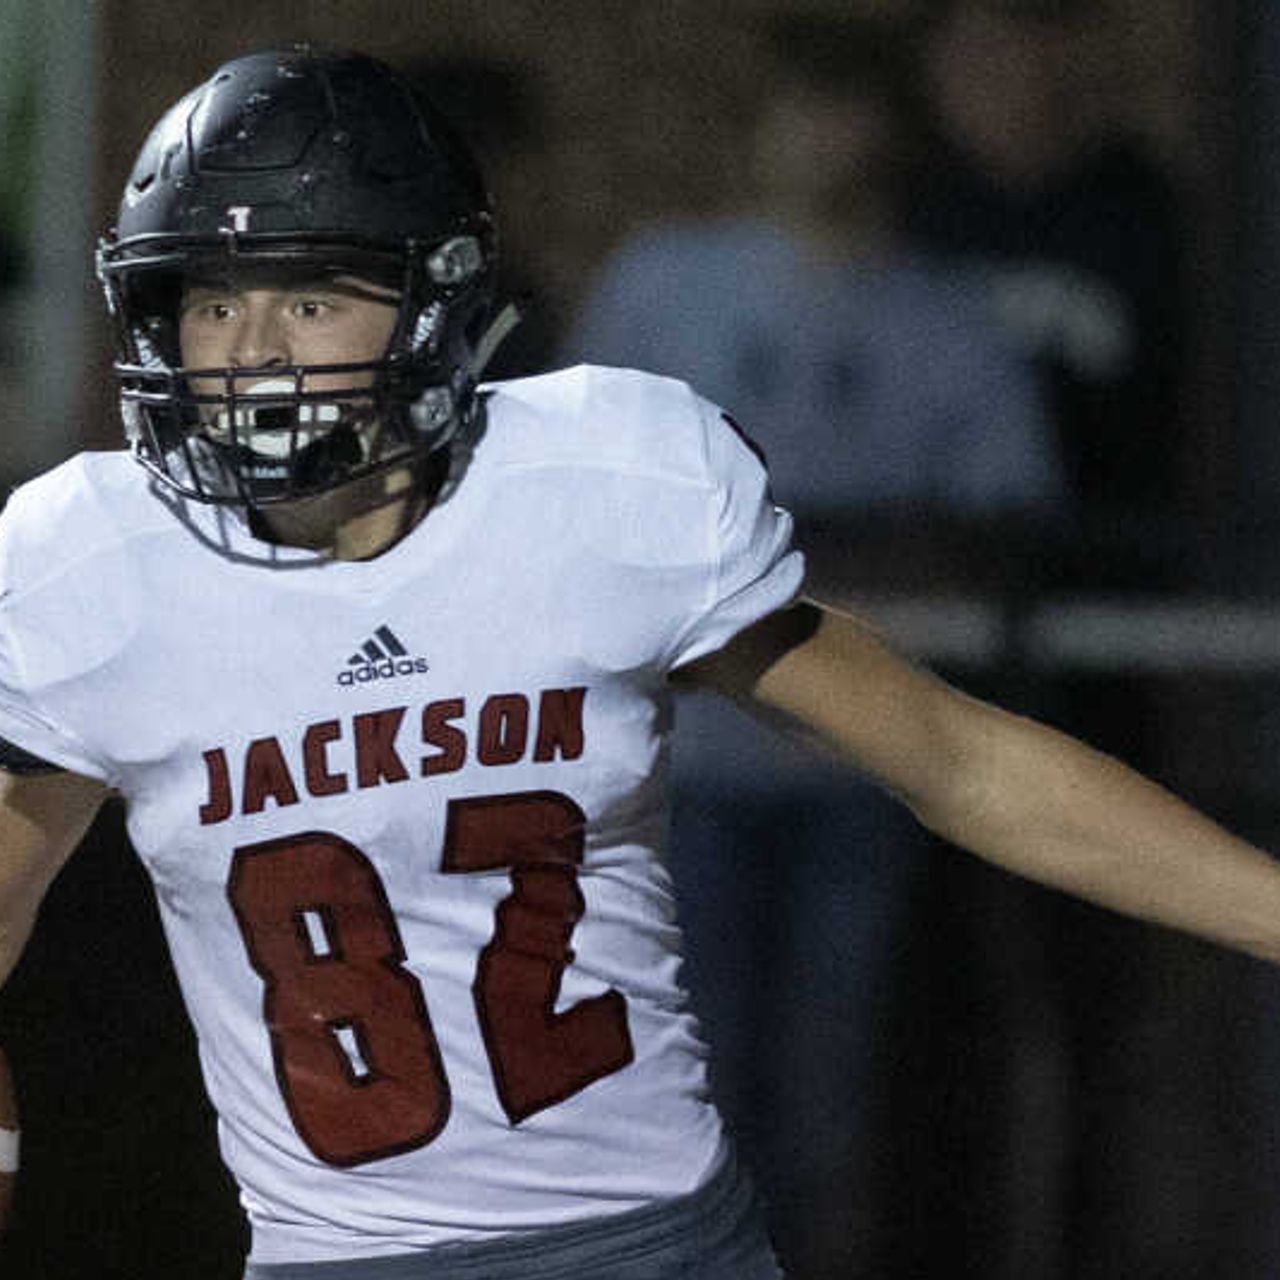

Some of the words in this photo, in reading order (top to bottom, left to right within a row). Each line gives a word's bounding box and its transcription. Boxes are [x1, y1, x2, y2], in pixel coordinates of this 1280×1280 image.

[337, 657, 429, 686] adidas
[199, 686, 588, 827] JACKSON
[226, 789, 636, 1169] 82
